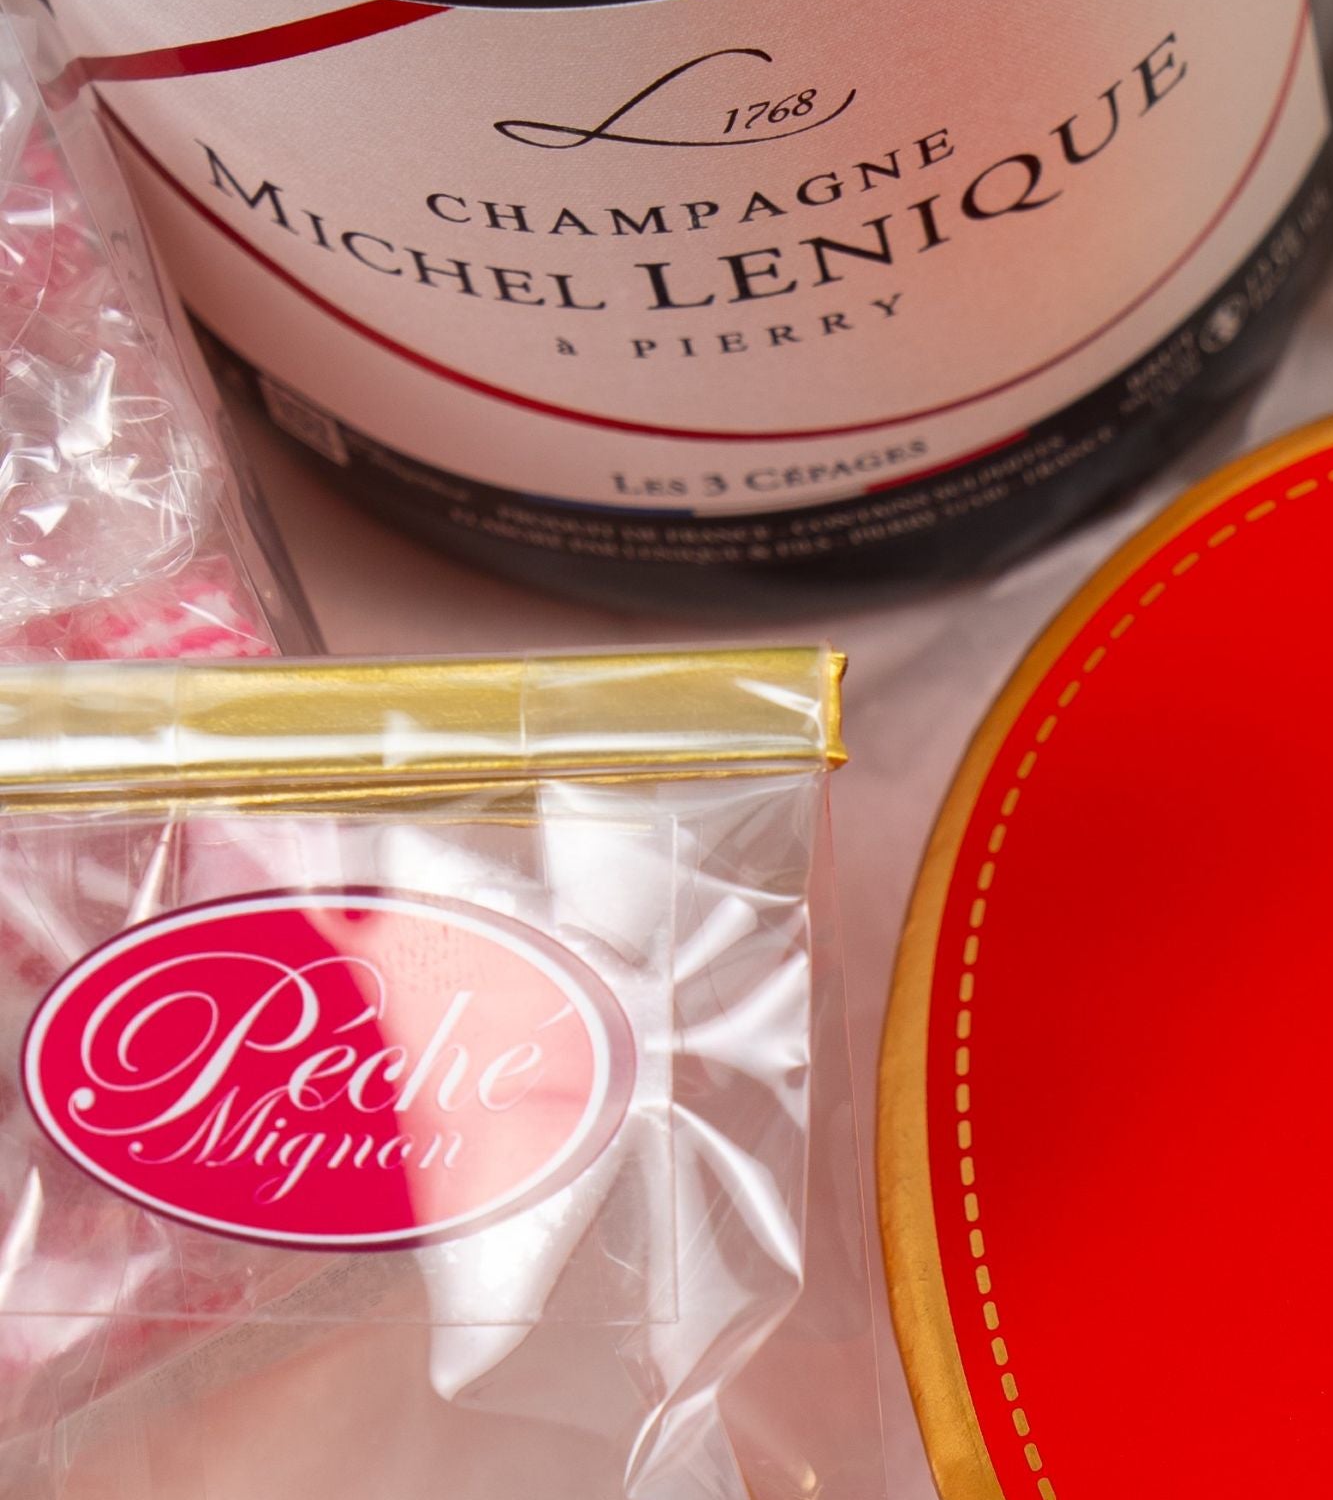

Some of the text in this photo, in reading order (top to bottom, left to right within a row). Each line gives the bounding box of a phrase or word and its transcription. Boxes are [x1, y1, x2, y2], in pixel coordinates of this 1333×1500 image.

[722, 88, 818, 135] 1768
[194, 138, 607, 311] MICHEL
[634, 31, 1188, 312] LENIQUE
[426, 128, 956, 236] CHAMPAGNE
[556, 293, 905, 360] à PIERRY
[701, 471, 729, 497] 3
[68, 950, 579, 1139] Péché
[128, 1083, 466, 1206] Mignon
